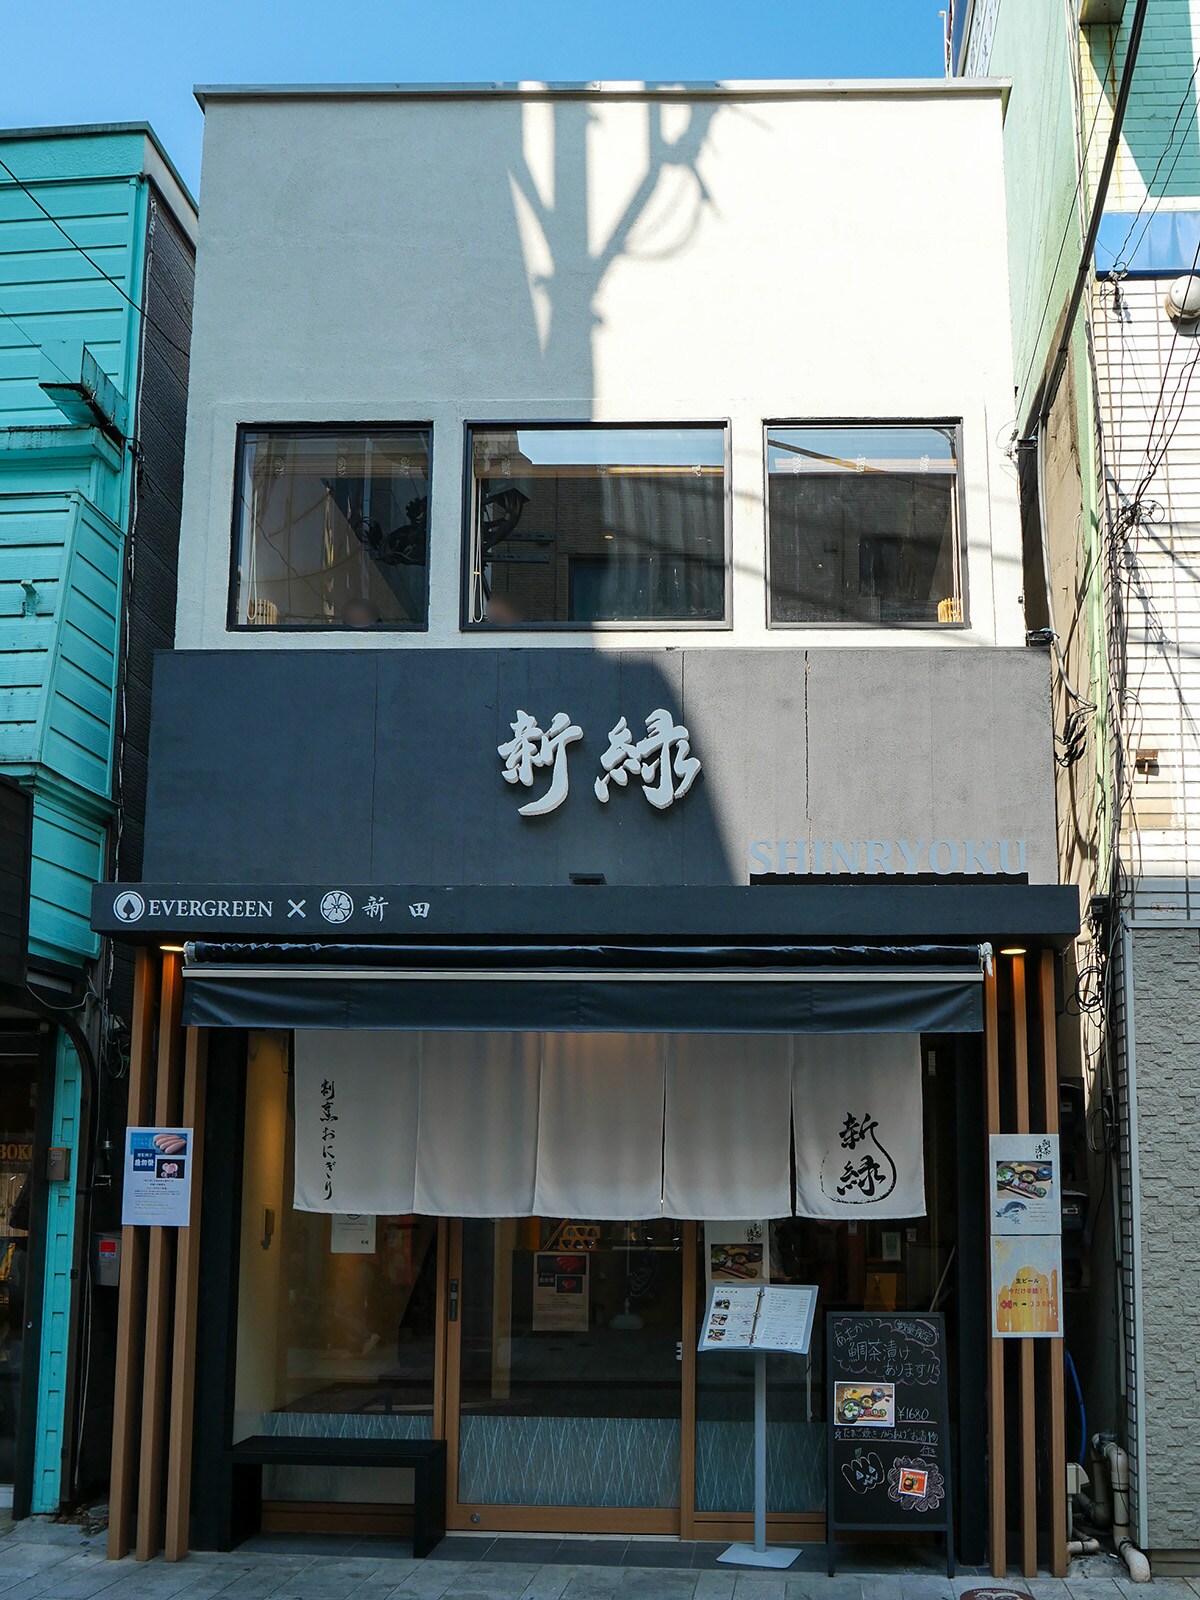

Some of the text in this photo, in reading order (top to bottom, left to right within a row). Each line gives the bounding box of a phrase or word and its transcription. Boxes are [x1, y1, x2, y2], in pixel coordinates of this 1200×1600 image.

[498, 708, 702, 816] 新緑
[750, 839, 1027, 874] SHINRYOKU
[148, 899, 273, 918] EVERGREEN
[831, 1111, 892, 1200] 新緑
[848, 1339, 909, 1362] 鯛茶漬け
[897, 1406, 930, 1420] ¥1680
